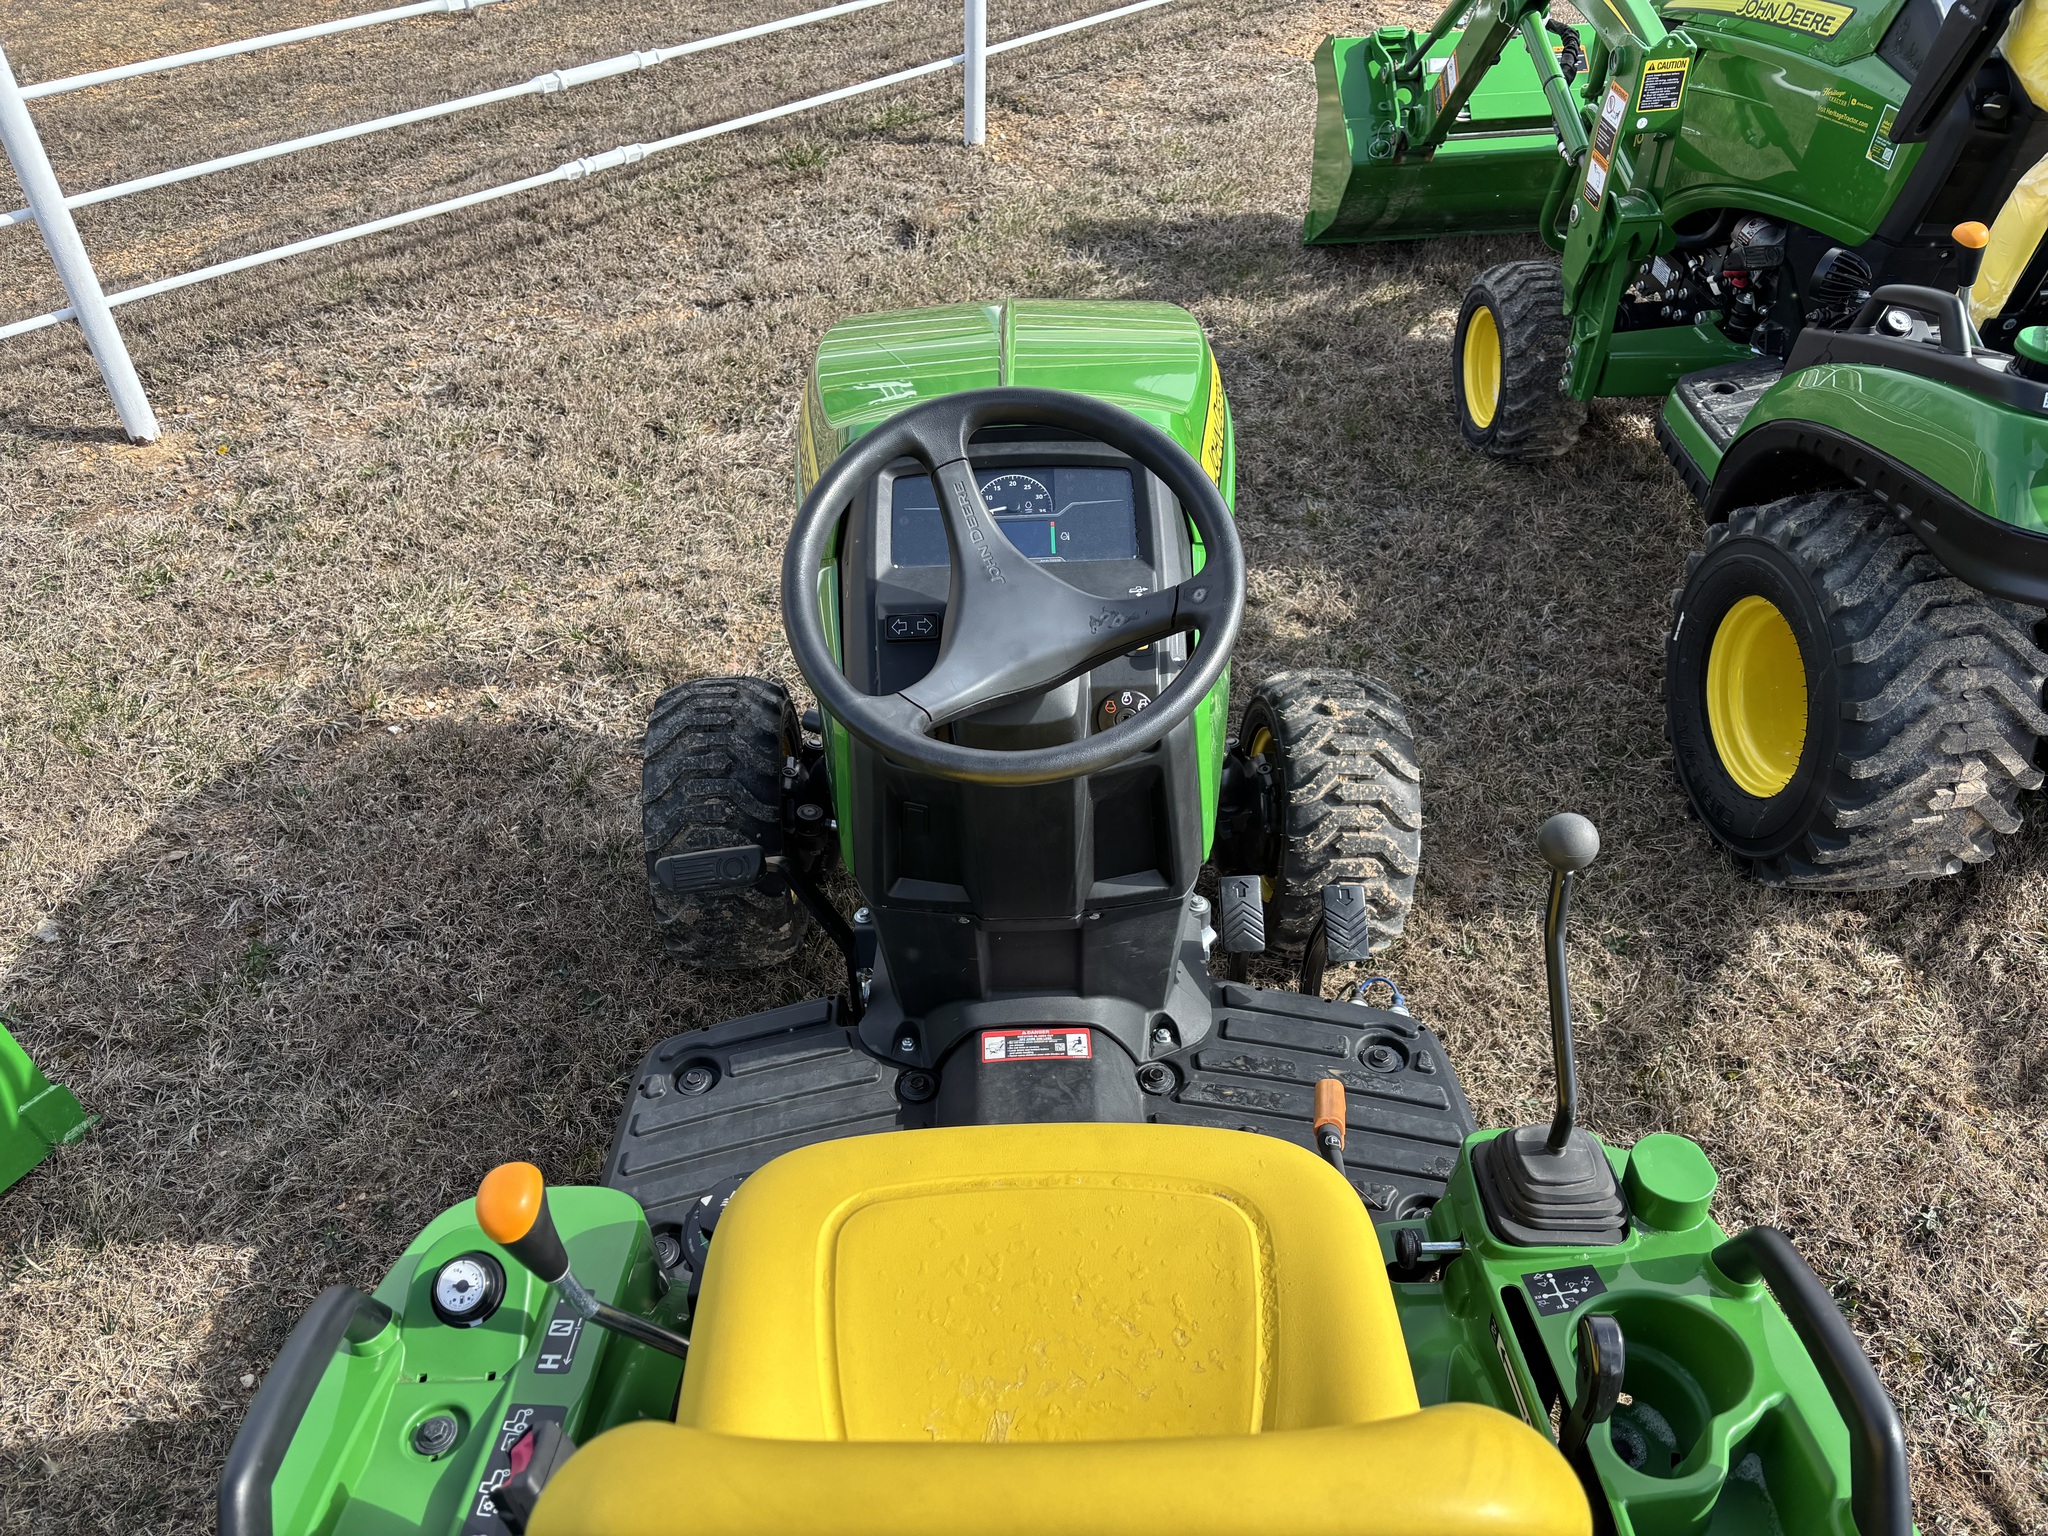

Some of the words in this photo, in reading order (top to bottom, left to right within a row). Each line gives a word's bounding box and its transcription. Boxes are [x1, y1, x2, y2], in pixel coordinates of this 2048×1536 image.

[1736, 0, 1780, 20] JOHN
[1780, 2, 1837, 34] DEERE
[1657, 60, 1687, 70] CAUTION
[953, 481, 984, 545] DEERE
[977, 545, 1007, 584] JOHN
[549, 1321, 573, 1335] N
[538, 1354, 562, 1369] H
